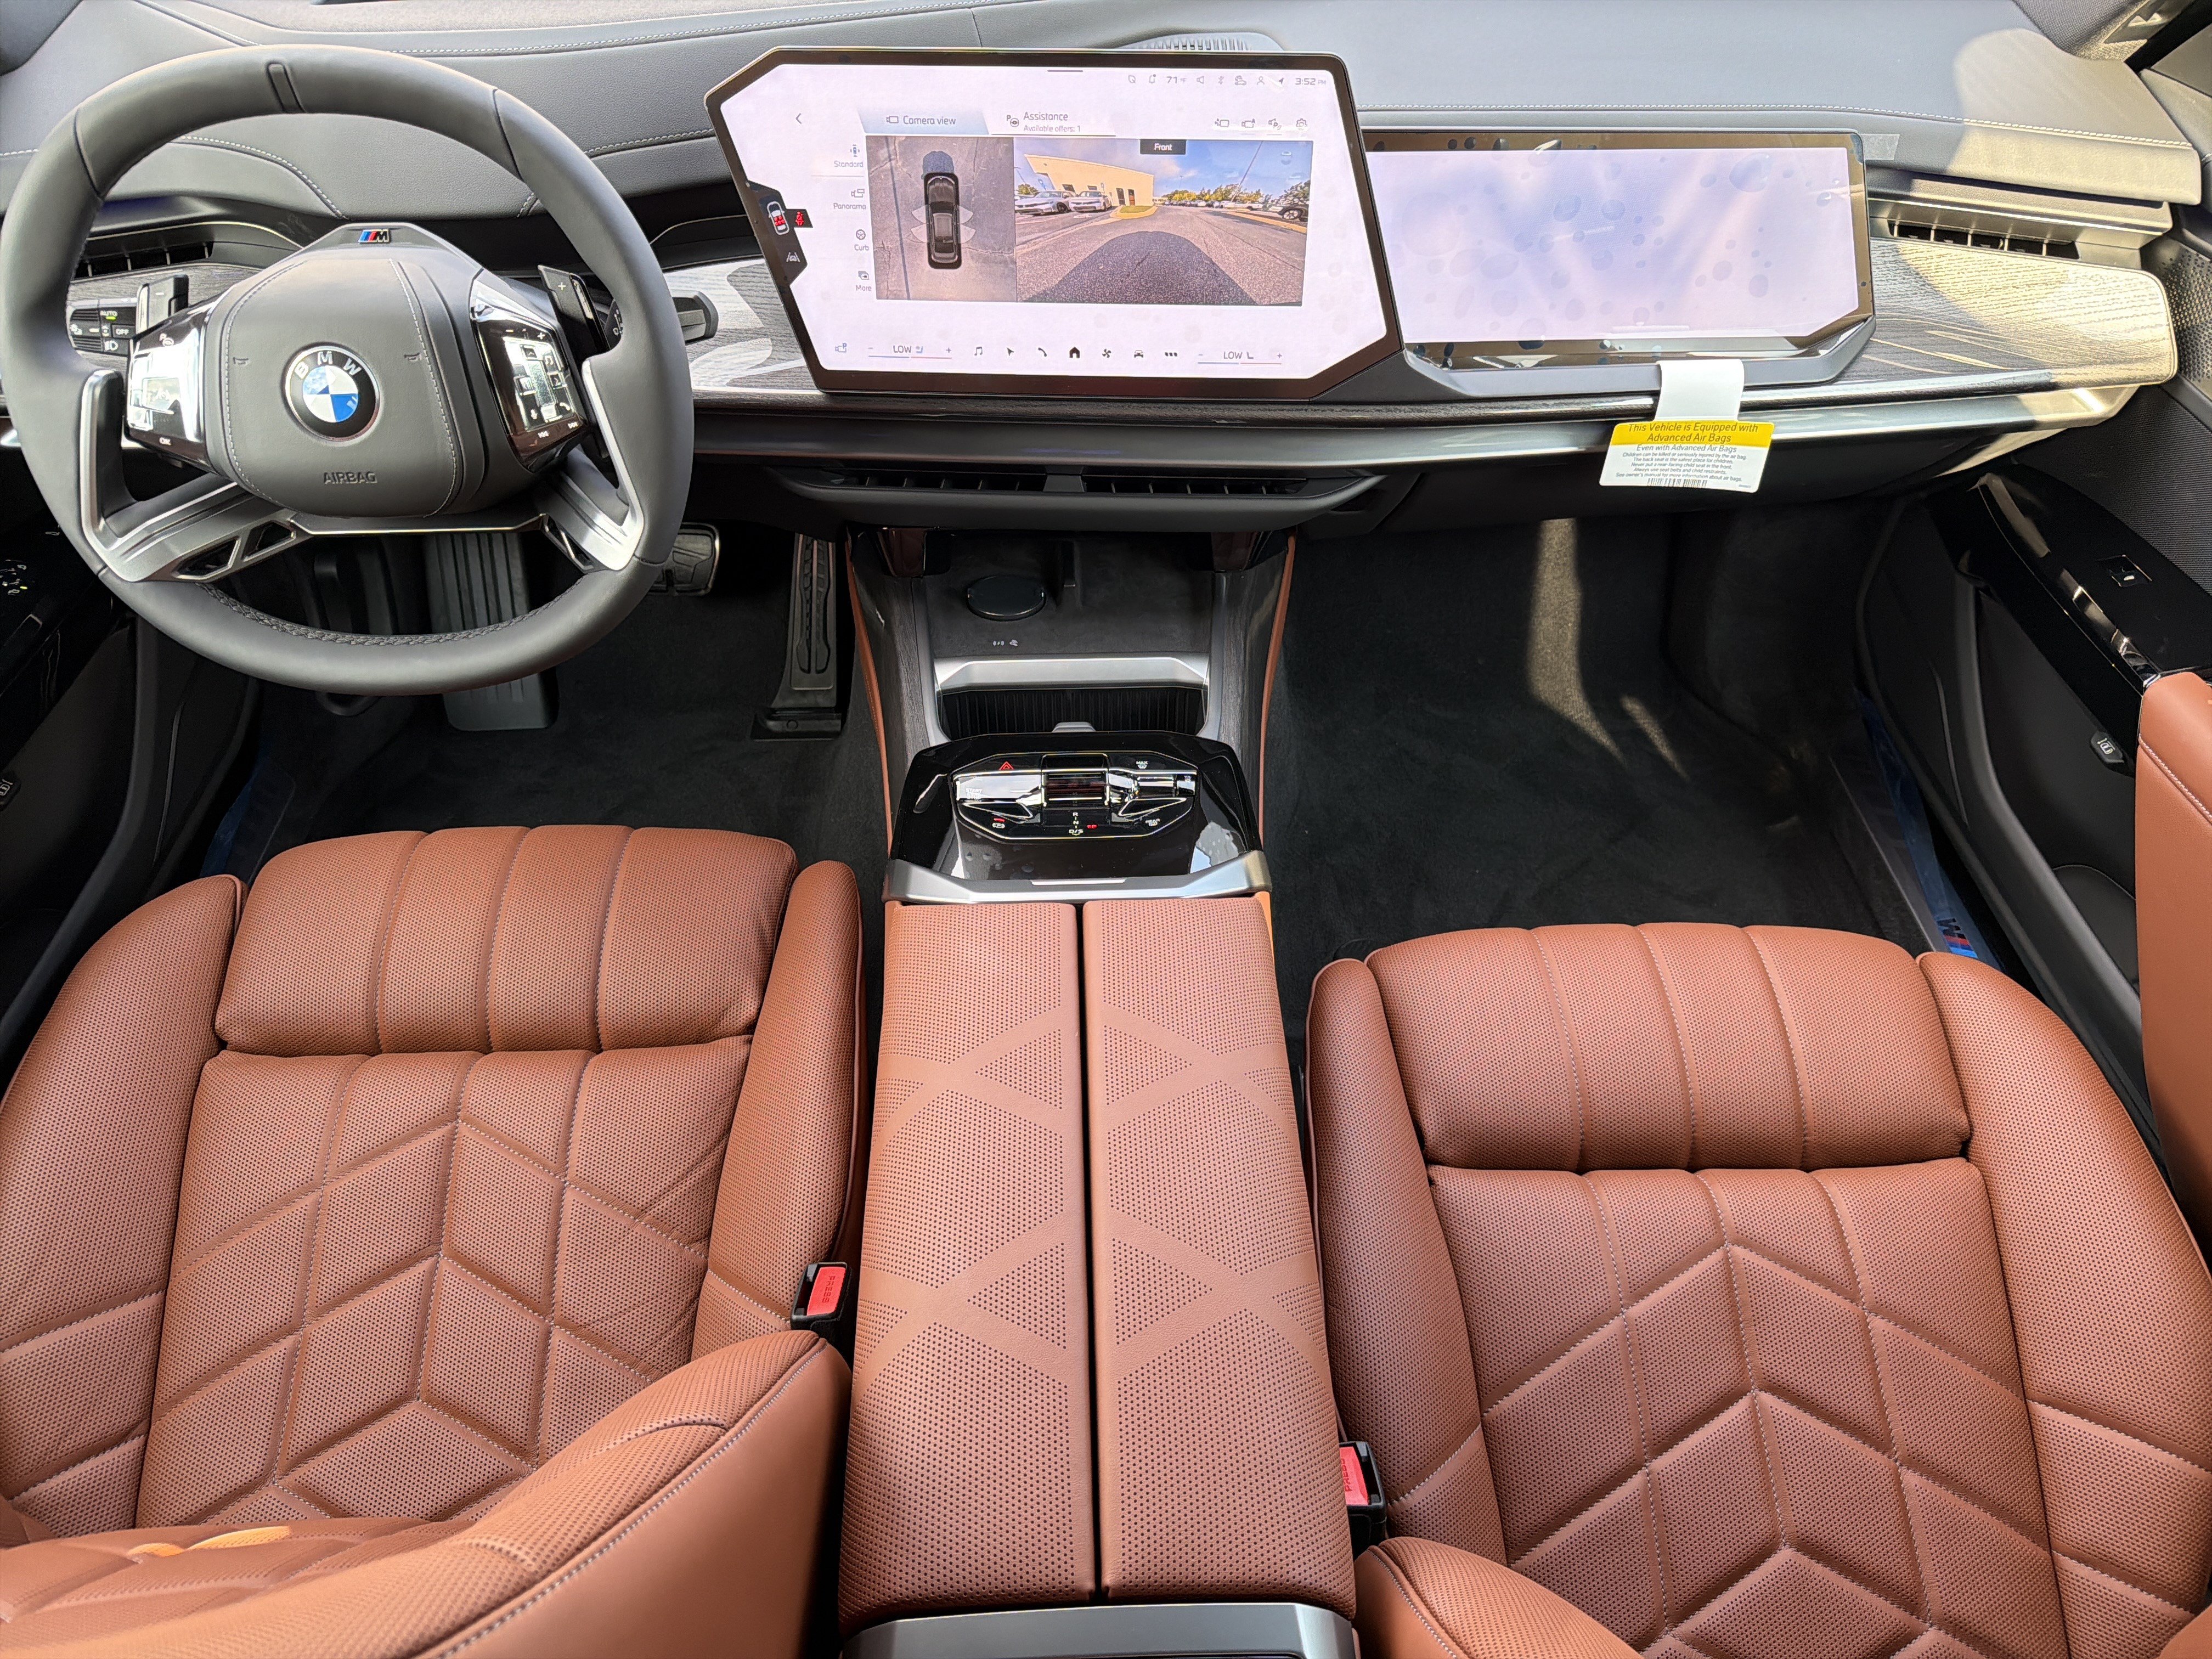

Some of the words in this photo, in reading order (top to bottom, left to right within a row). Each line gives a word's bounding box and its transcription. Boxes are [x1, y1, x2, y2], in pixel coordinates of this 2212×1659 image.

[1295, 77, 1316, 86] 3:52
[903, 115, 934, 126] Camera
[936, 116, 956, 125] view
[1023, 111, 1069, 121] Assistance
[1154, 142, 1172, 151] Front
[893, 345, 912, 354] LOW
[1223, 351, 1243, 359] LOW
[295, 351, 362, 379] BMW
[1629, 424, 1646, 432] This
[1650, 422, 1682, 432] Vehicle
[1684, 423, 1691, 431] is
[1694, 422, 1738, 433] Equipped
[1739, 424, 1758, 432] with
[159, 437, 172, 446] OK
[1647, 433, 1692, 442] Advanced
[1693, 433, 1707, 442] Air
[1708, 433, 1732, 444] Bags
[1719, 445, 1737, 454] Bags
[324, 471, 377, 484] AIRBAG
[822, 1275, 836, 1303] PRESS
